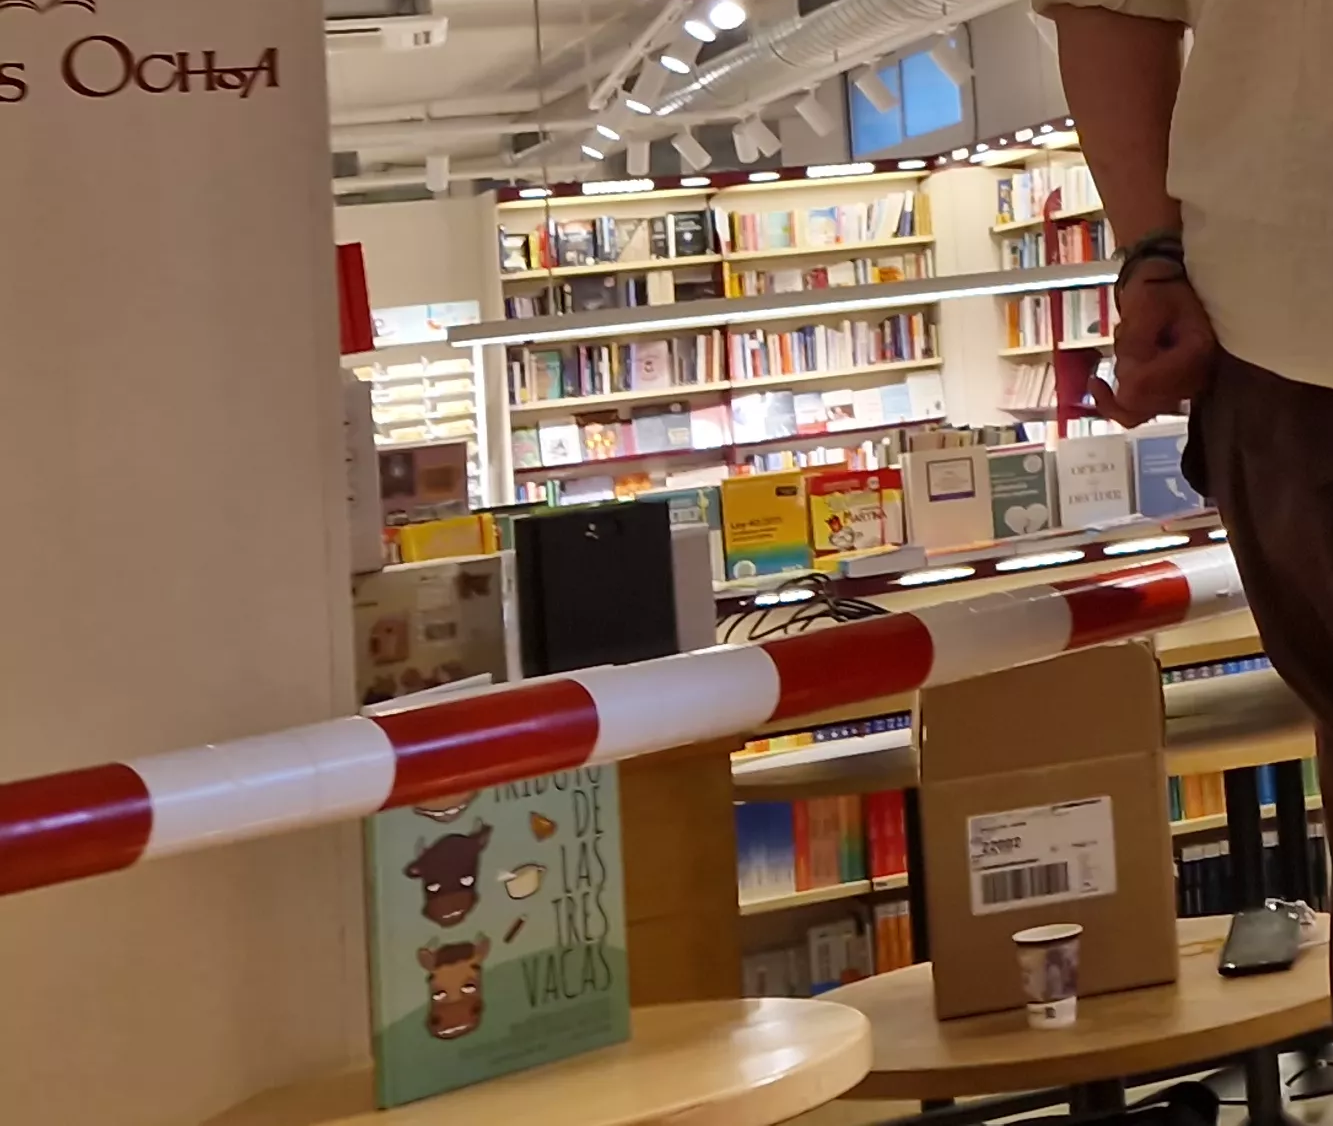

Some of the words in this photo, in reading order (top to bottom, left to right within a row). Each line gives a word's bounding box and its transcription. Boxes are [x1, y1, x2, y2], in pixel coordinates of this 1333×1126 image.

[573, 785, 604, 838] DE
[560, 836, 606, 894] LAS
[551, 890, 611, 947] TRES
[521, 945, 614, 1007] VACAS
